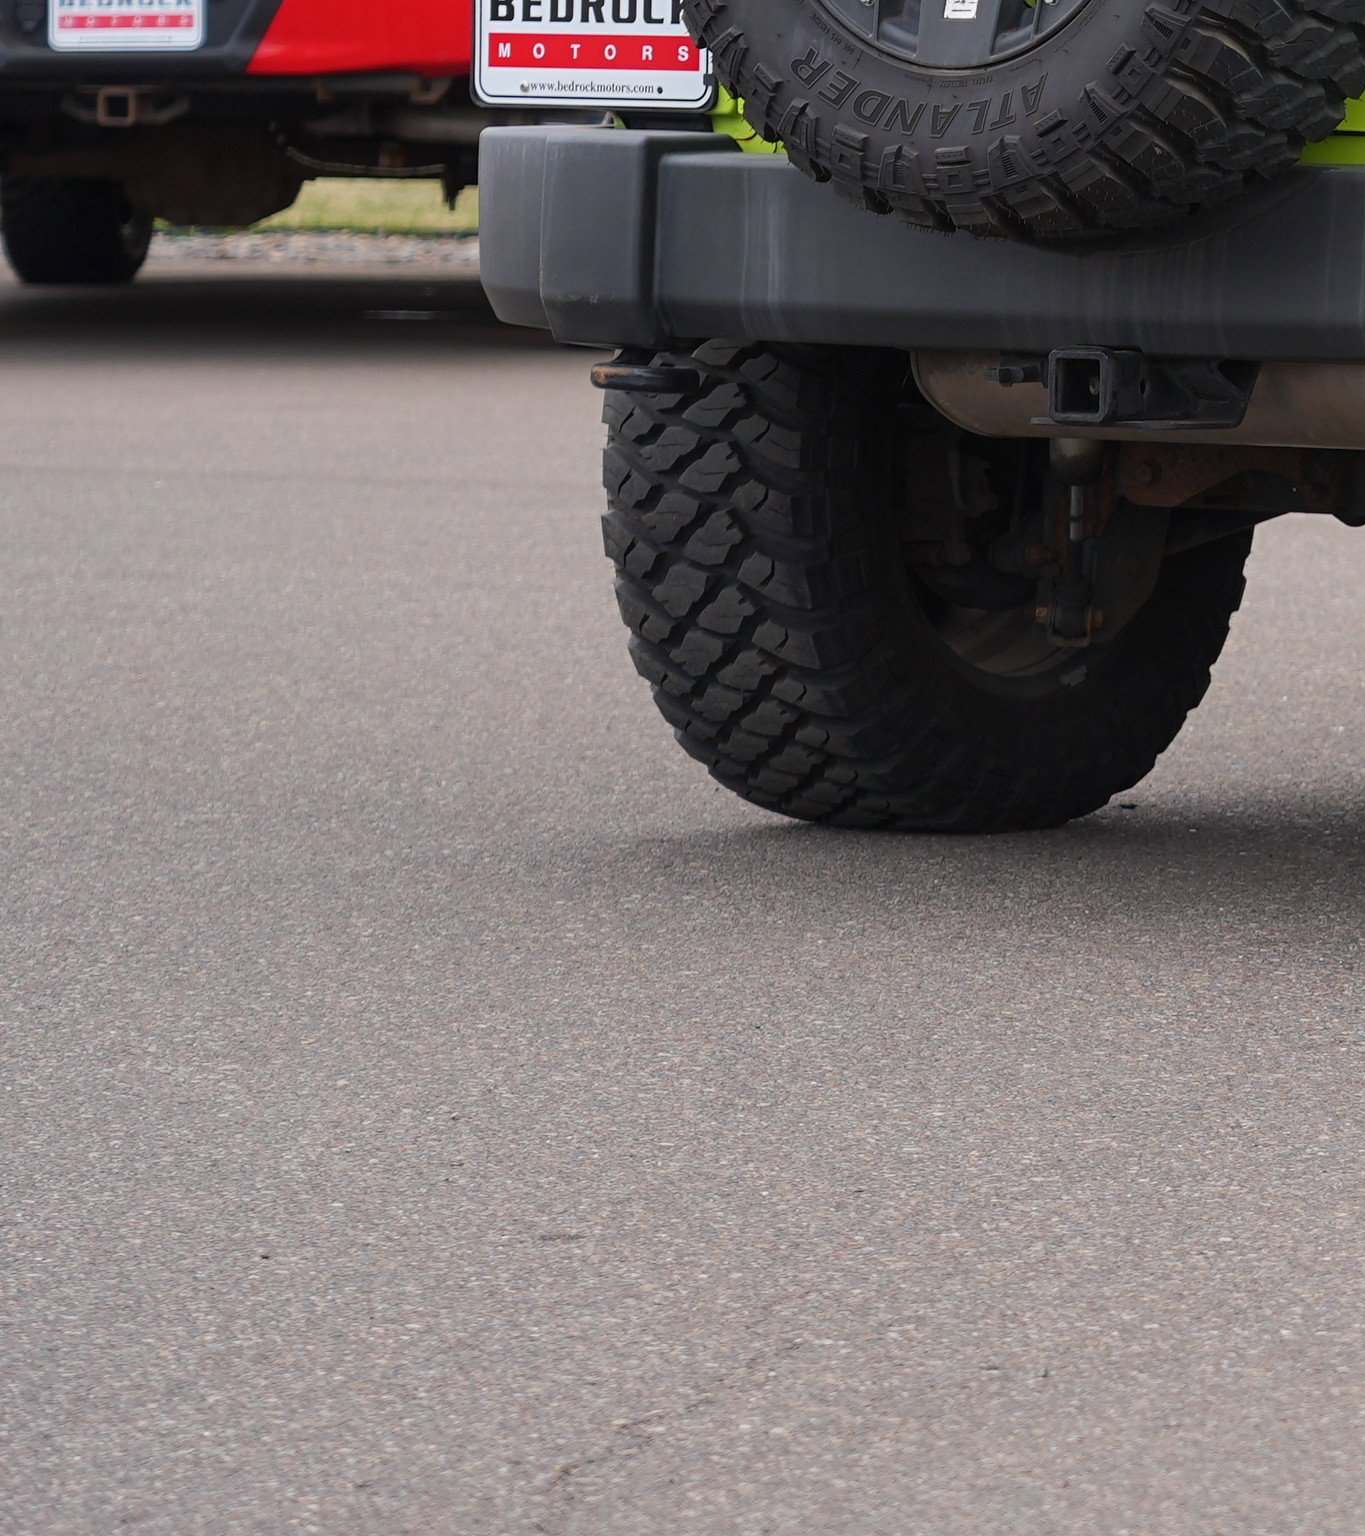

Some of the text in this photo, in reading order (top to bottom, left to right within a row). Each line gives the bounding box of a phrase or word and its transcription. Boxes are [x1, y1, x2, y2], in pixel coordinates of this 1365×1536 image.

[64, 15, 190, 26] MOTORS
[497, 42, 691, 63] MOTORS
[530, 80, 655, 95] www.bedrockmotors.com
[789, 46, 1049, 138] ATLANDER
